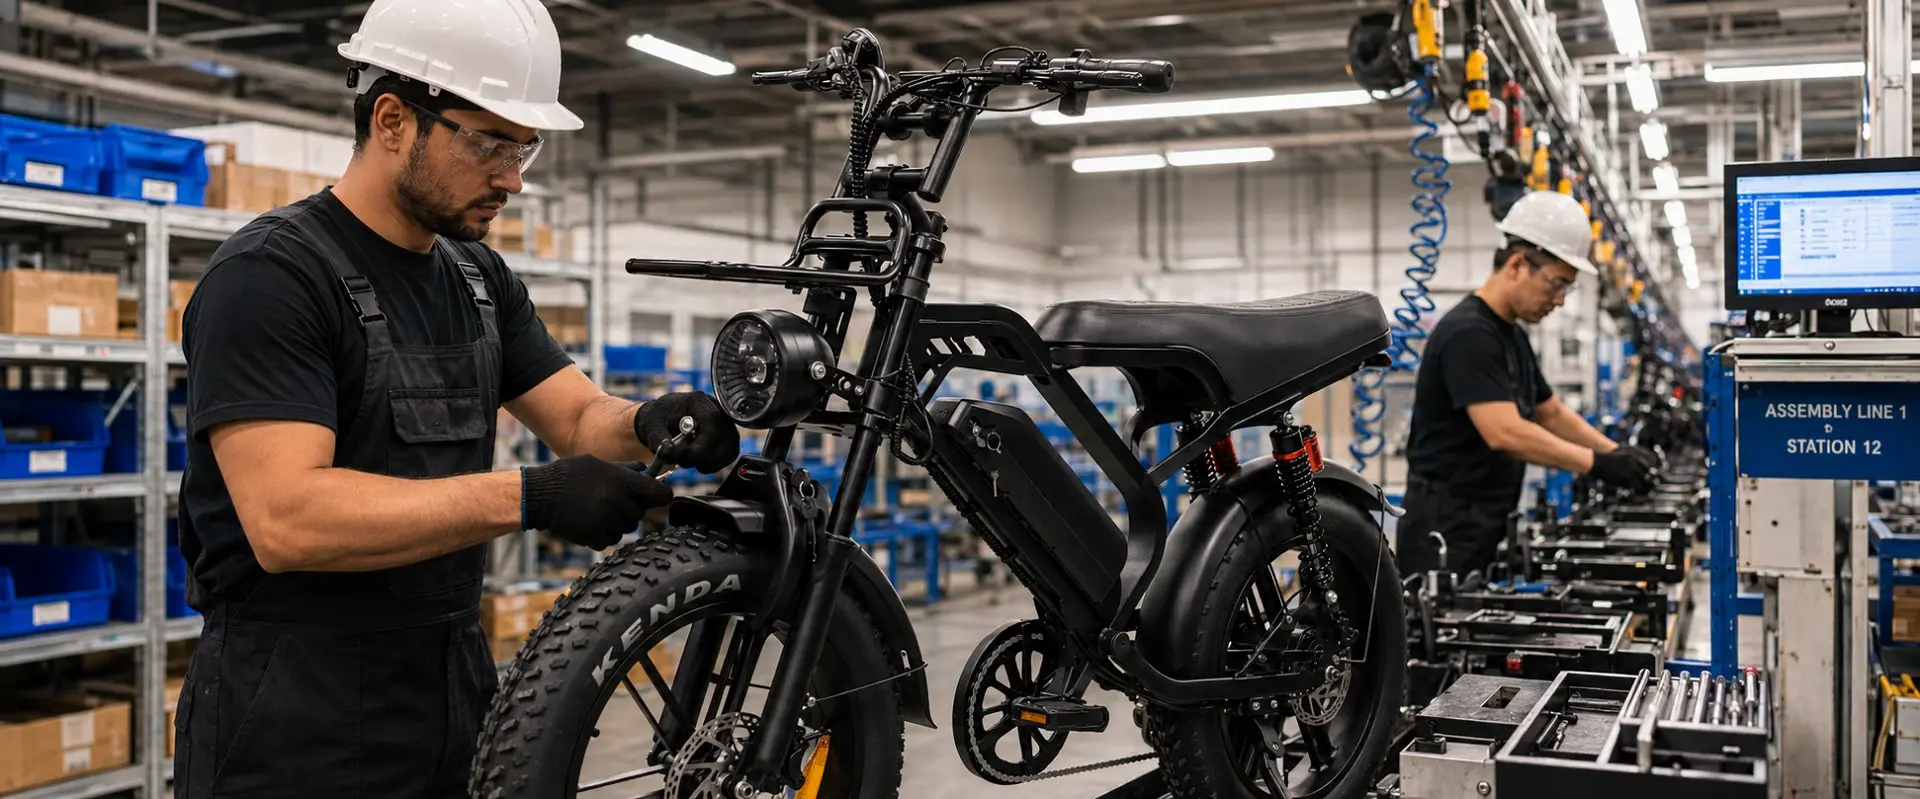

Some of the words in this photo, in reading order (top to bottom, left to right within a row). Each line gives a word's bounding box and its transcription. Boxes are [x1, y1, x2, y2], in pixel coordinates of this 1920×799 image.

[1765, 403, 1852, 419] ASSEMBLY
[1857, 404, 1894, 419] LINE
[1899, 405, 1907, 420] 1
[1787, 438, 1856, 454] STATION
[1863, 440, 1882, 455] 12
[591, 573, 741, 687] KENDA
